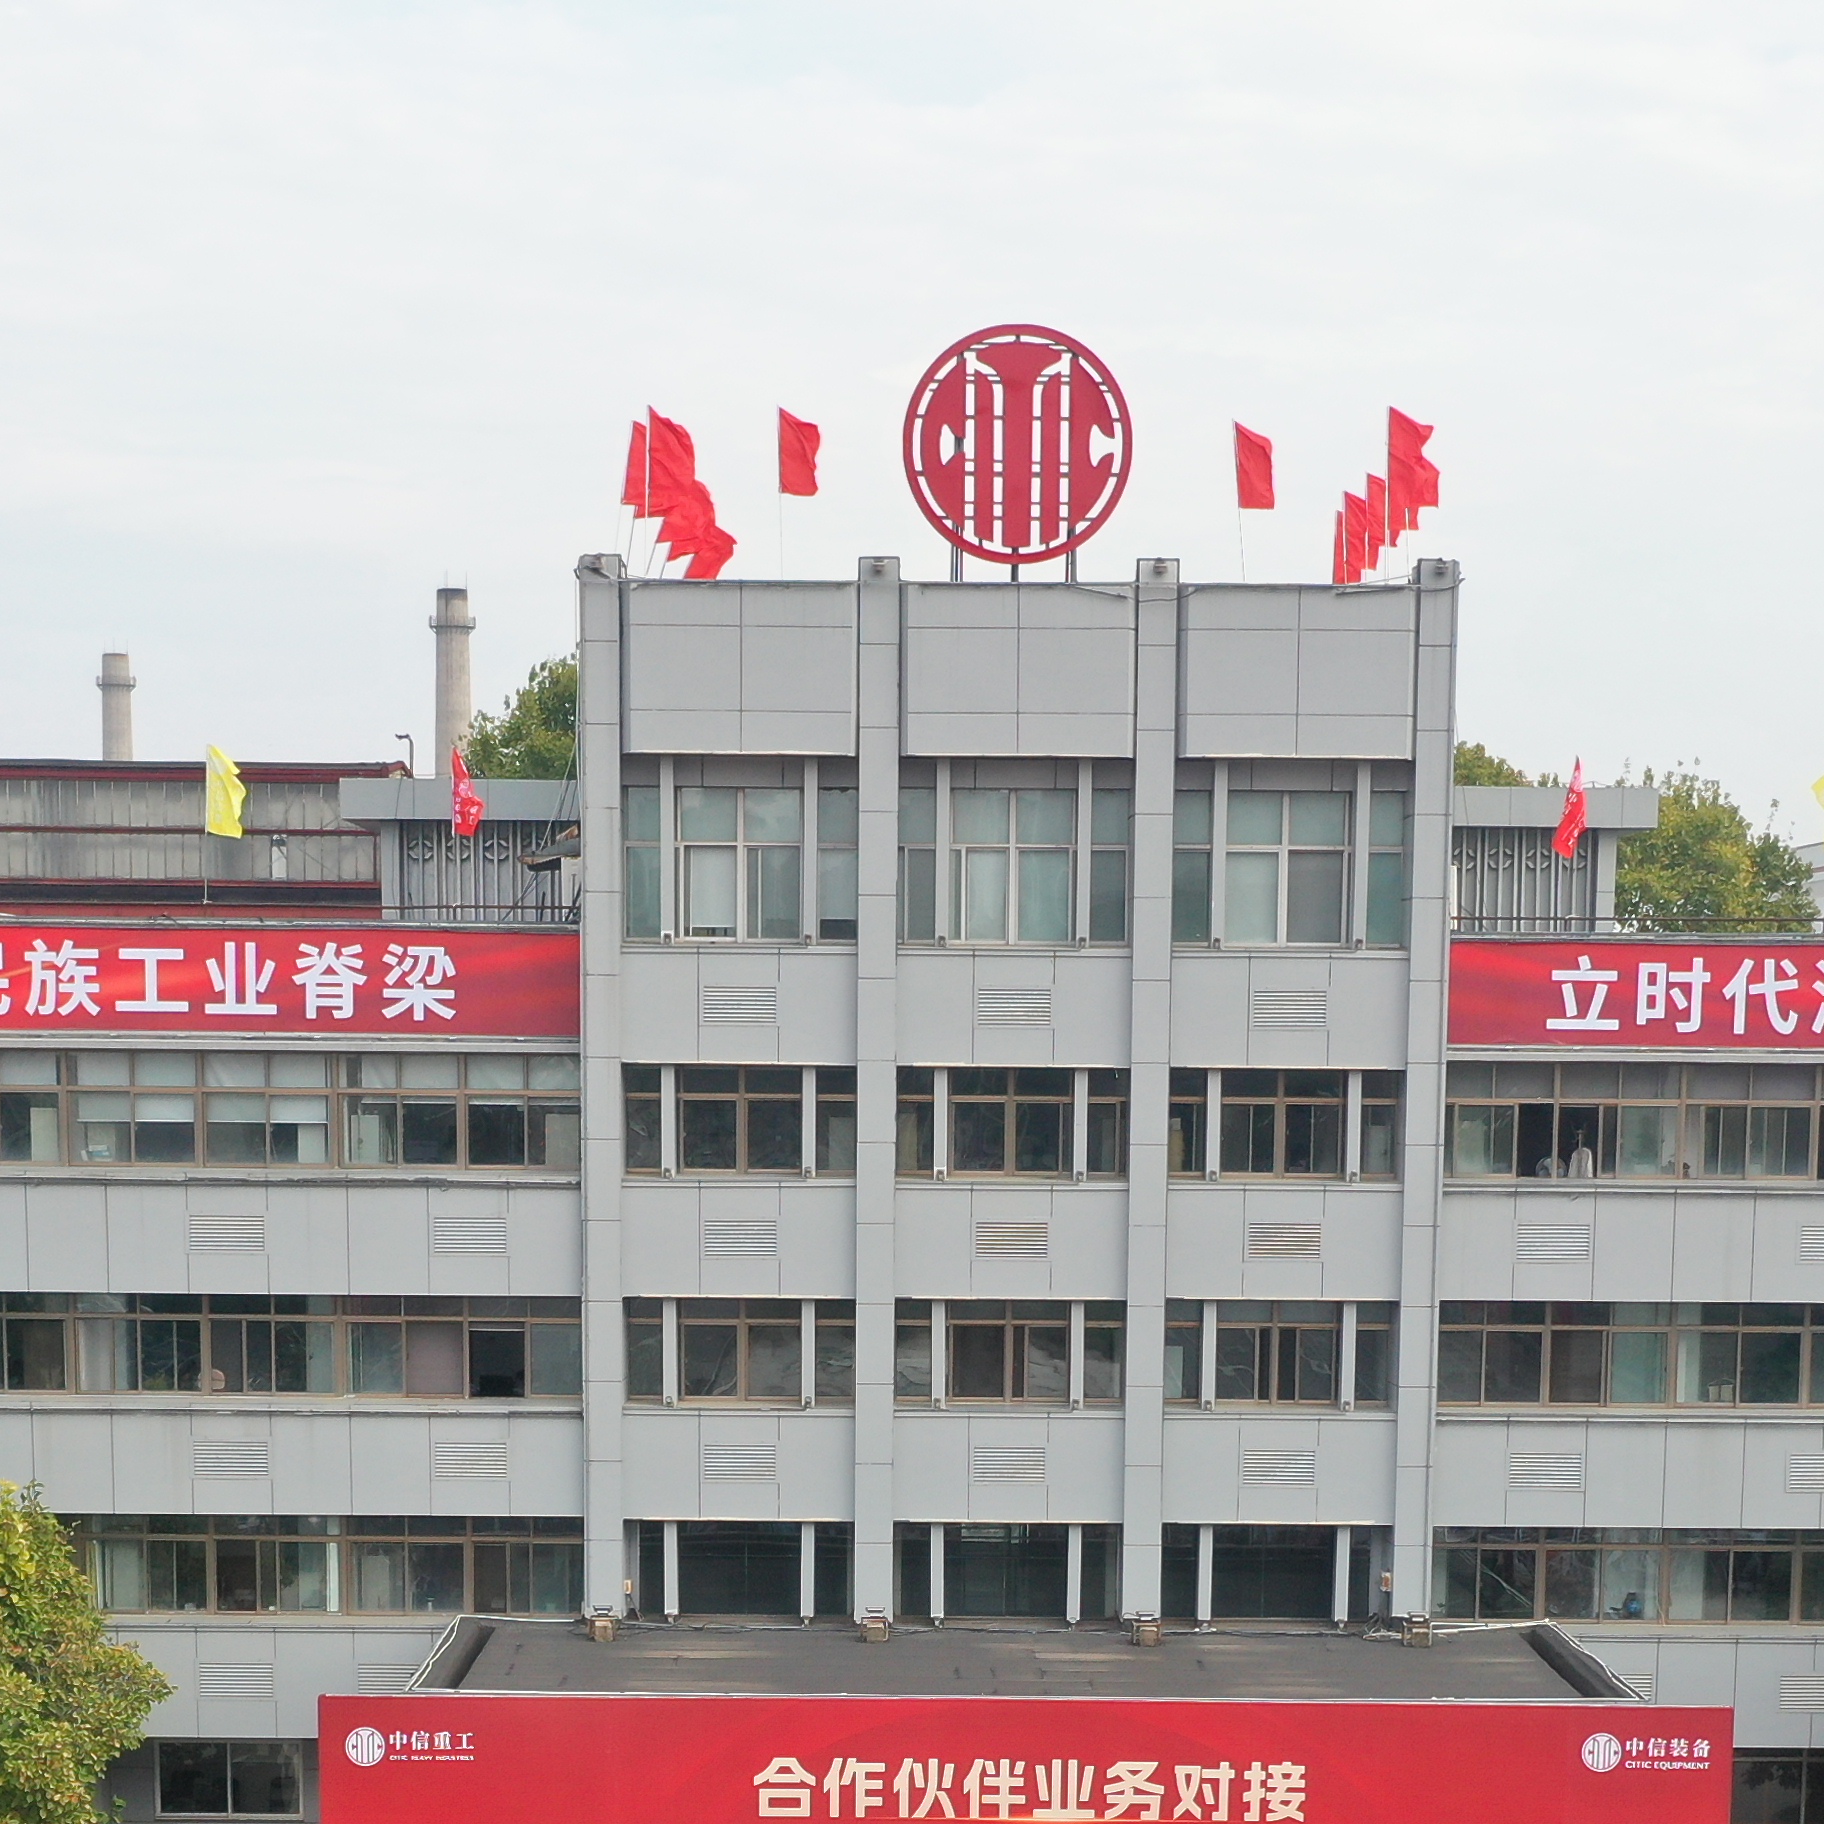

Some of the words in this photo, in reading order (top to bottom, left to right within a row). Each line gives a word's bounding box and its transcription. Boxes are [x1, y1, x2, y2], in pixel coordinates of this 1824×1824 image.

[389, 1730, 475, 1751] 中信重工
[1626, 1737, 1711, 1758] 中信装备
[753, 1757, 1307, 1823] 合作伙伴业务对接
